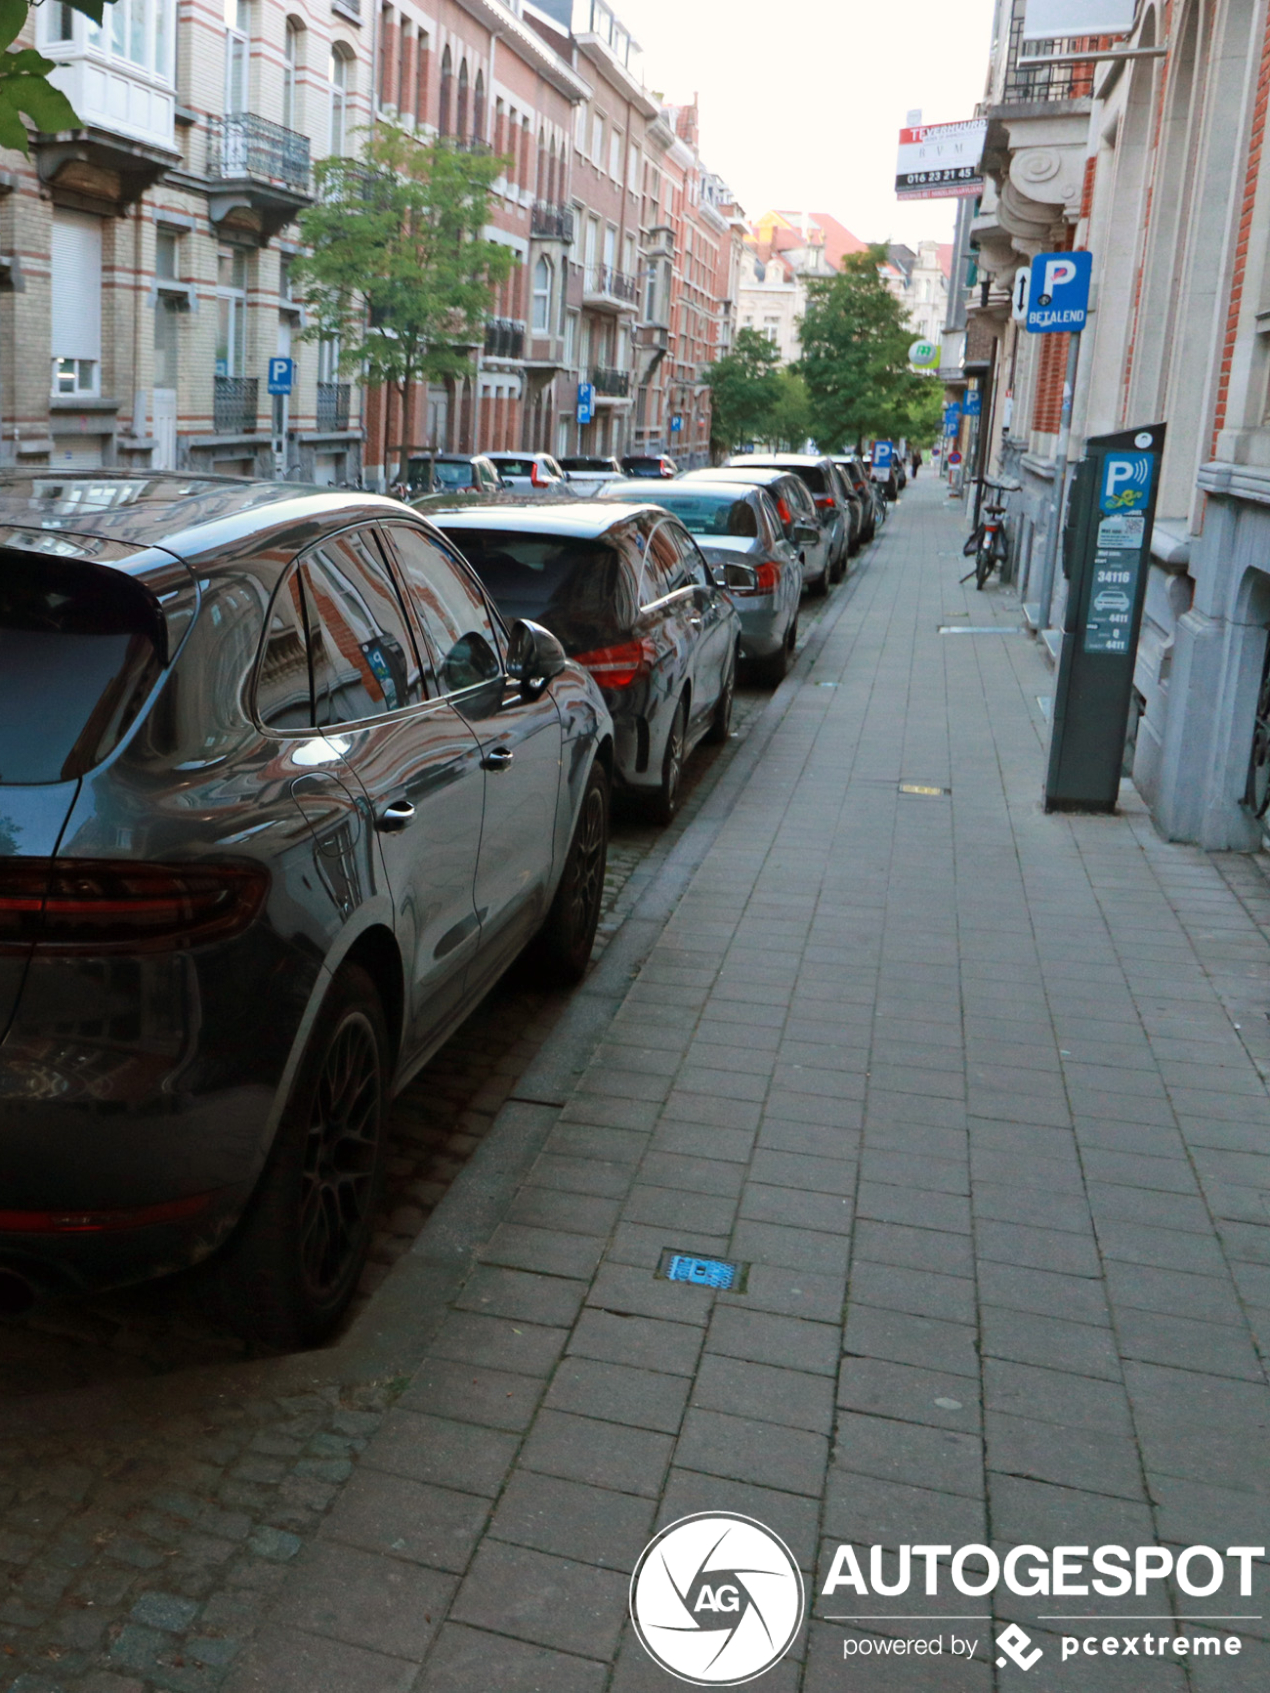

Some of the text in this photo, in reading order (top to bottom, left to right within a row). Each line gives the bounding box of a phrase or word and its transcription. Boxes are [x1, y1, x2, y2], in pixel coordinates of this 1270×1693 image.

[907, 168, 972, 184] 016 23 21 45
[1043, 260, 1077, 298] P
[1028, 310, 1085, 325] BETALEND
[273, 361, 288, 381] P
[580, 385, 589, 397] P
[966, 391, 979, 406] P
[578, 404, 589, 419] P
[947, 423, 956, 435] P
[874, 443, 890, 465] P
[1106, 461, 1134, 496] P
[1097, 570, 1130, 583] 34116
[1109, 613, 1128, 623] 4411
[1105, 640, 1125, 650] 4411
